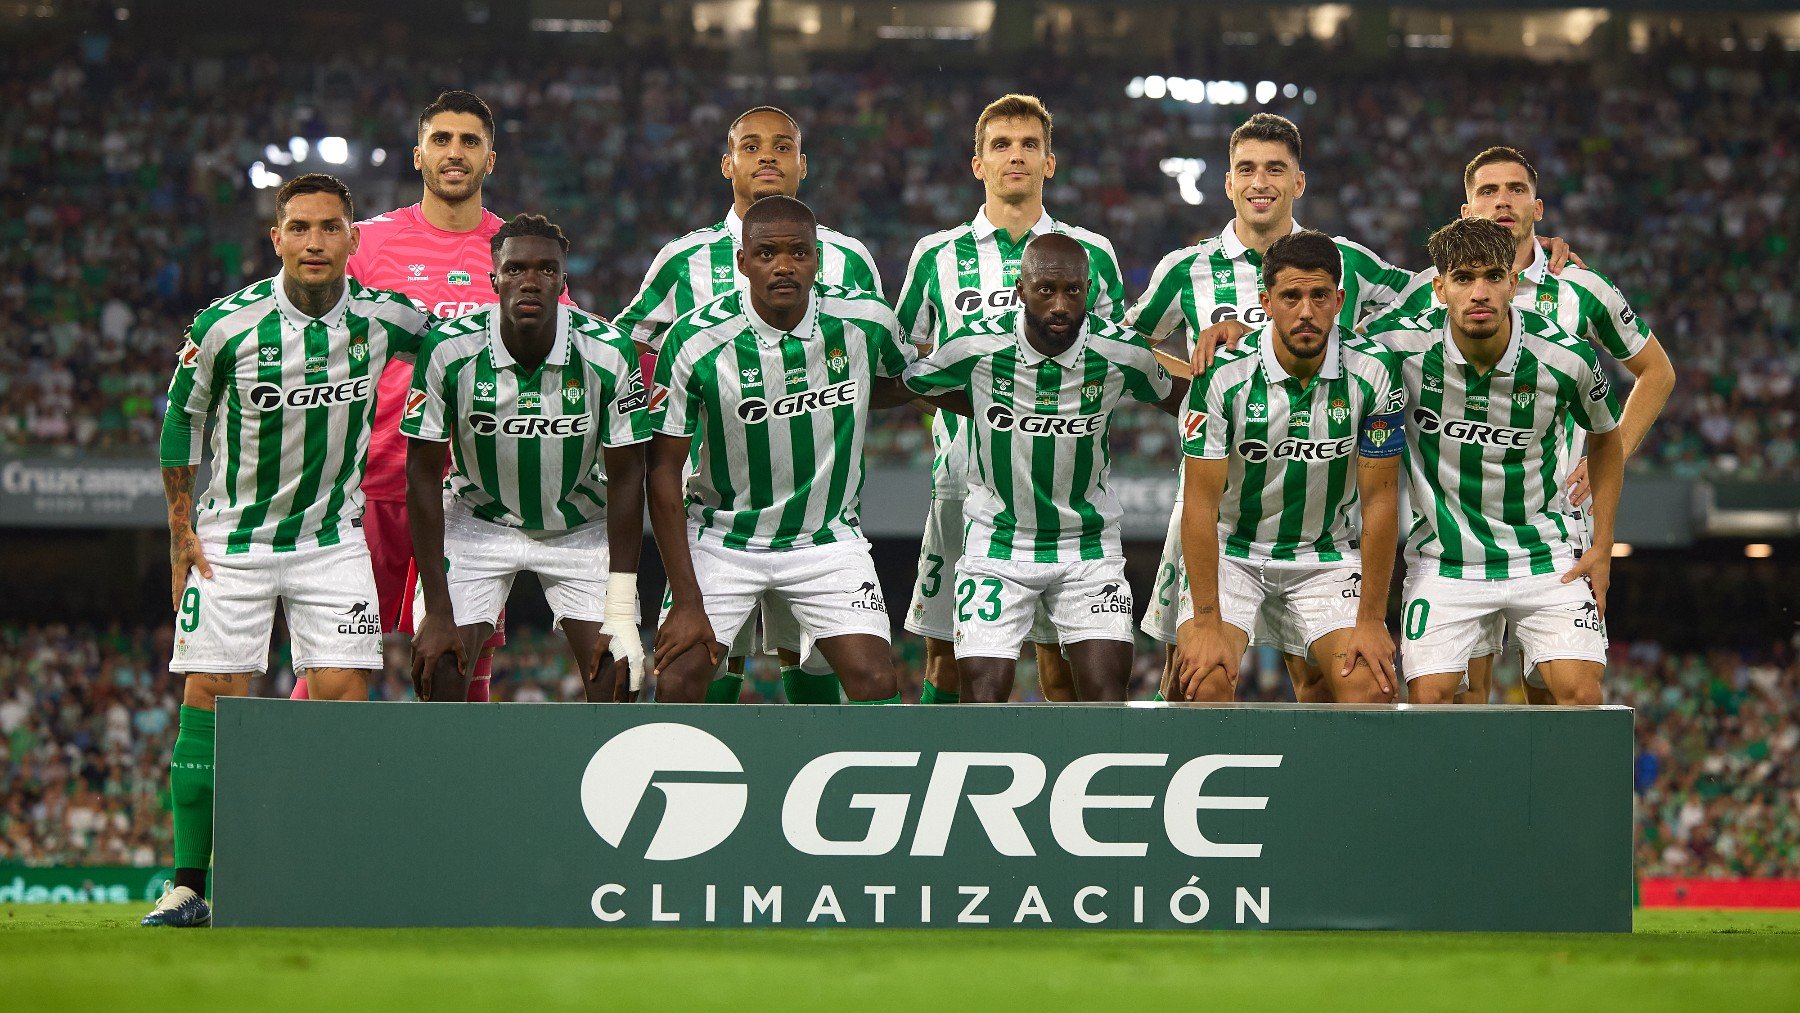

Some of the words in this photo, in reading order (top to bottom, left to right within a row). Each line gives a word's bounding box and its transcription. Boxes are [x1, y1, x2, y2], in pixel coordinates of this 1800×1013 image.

[258, 359, 281, 367] hummel
[286, 377, 371, 407] GREE
[741, 380, 763, 389] hummel
[619, 395, 648, 411] REV
[773, 381, 856, 417] GREE
[502, 414, 590, 435] GREE
[1019, 413, 1105, 435] GREE
[1443, 420, 1535, 446] GREE
[1273, 436, 1354, 460] GREE
[921, 553, 944, 598] 3
[180, 586, 200, 633] 9
[957, 578, 1004, 622] 23
[338, 624, 381, 635] GLOBA
[781, 751, 1283, 858] GREE
[590, 874, 1271, 925] CLIMATIZACIÓN
